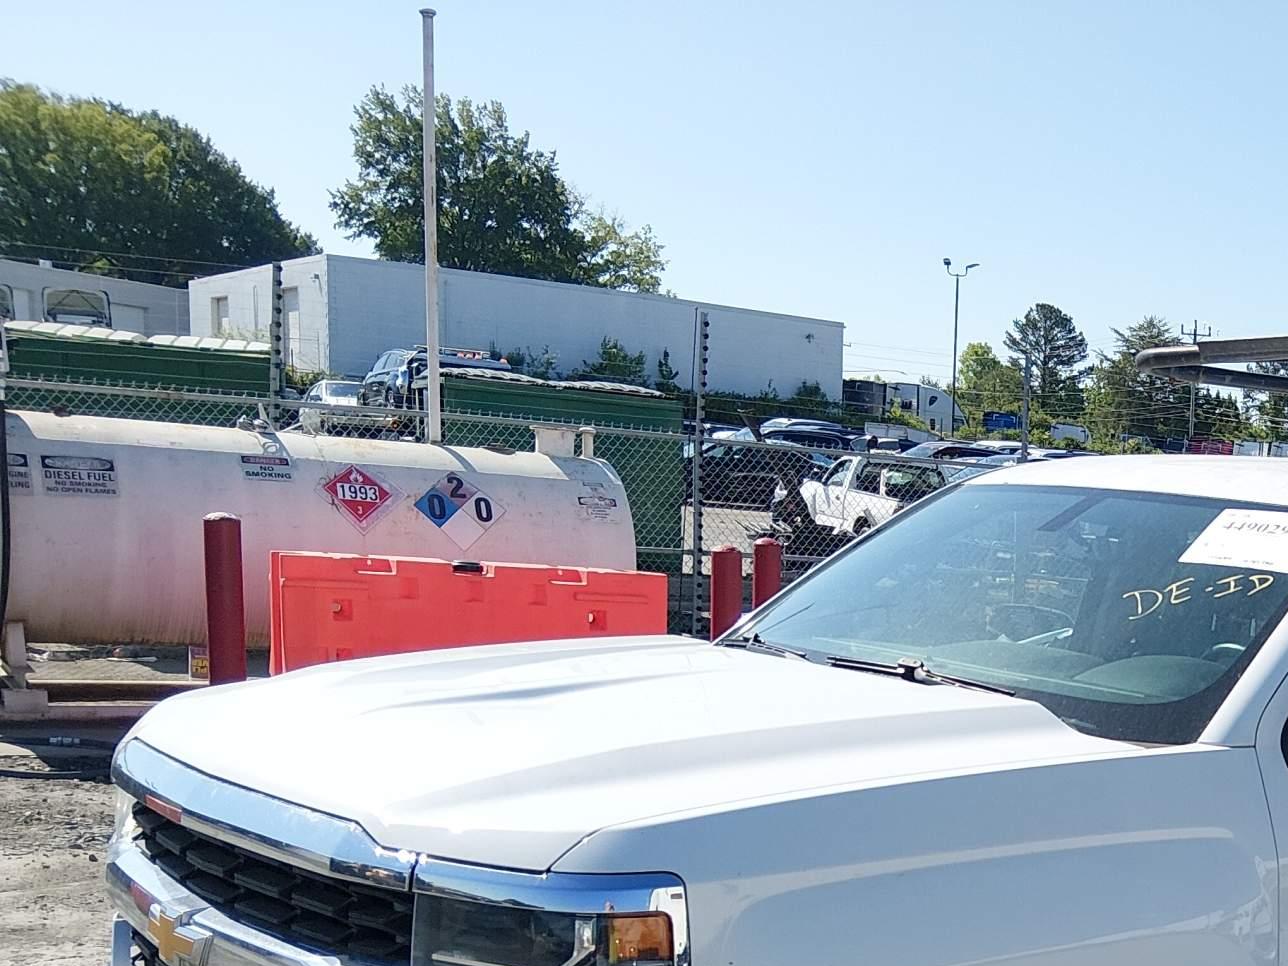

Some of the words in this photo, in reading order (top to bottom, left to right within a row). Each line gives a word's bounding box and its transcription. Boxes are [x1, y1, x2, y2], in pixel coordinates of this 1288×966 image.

[44, 470, 85, 480] DIESEL
[87, 471, 115, 482] FUEL
[245, 470, 292, 479] SMOKING
[54, 479, 67, 487] NO
[69, 480, 108, 488] SMOKING
[61, 486, 83, 494] OPEN
[85, 487, 117, 495] FLAMES
[446, 476, 467, 499] 2
[338, 484, 379, 501] 1993
[428, 494, 446, 520] 0
[474, 497, 493, 523] 0
